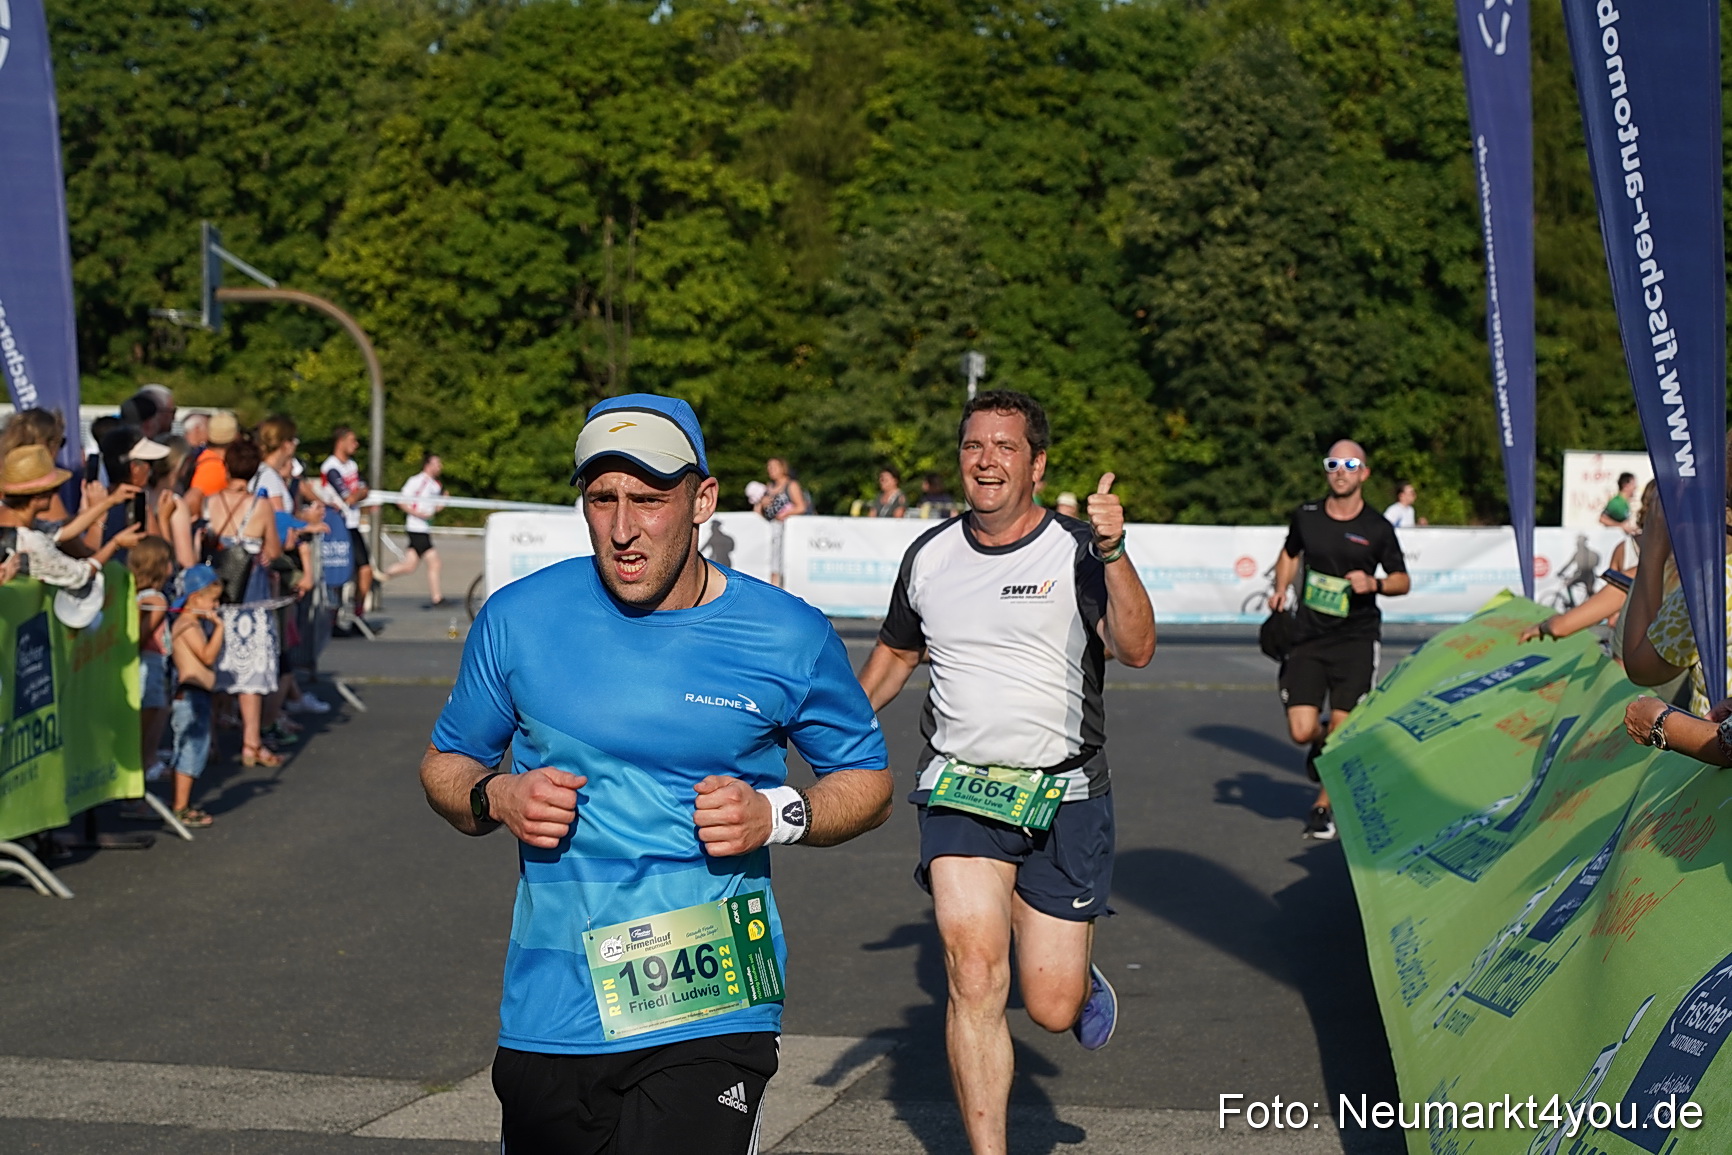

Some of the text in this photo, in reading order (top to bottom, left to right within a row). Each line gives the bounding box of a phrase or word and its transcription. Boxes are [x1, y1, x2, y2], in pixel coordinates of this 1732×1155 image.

[685, 693, 742, 709] RAILONE
[936, 777, 952, 796] RUN
[954, 775, 1018, 803] 1664
[984, 798, 1004, 809] Uwe
[1011, 791, 1030, 818] 2022
[625, 931, 672, 953] Firmenlauf
[618, 943, 719, 997] 1946
[718, 944, 740, 996] 2022
[602, 977, 622, 1018] RUN
[628, 983, 721, 1014] Friedl Ludwig
[1680, 991, 1732, 1035] Fischer
[1668, 1033, 1709, 1057] AUTOMOBILE
[717, 1095, 748, 1114] adidas
